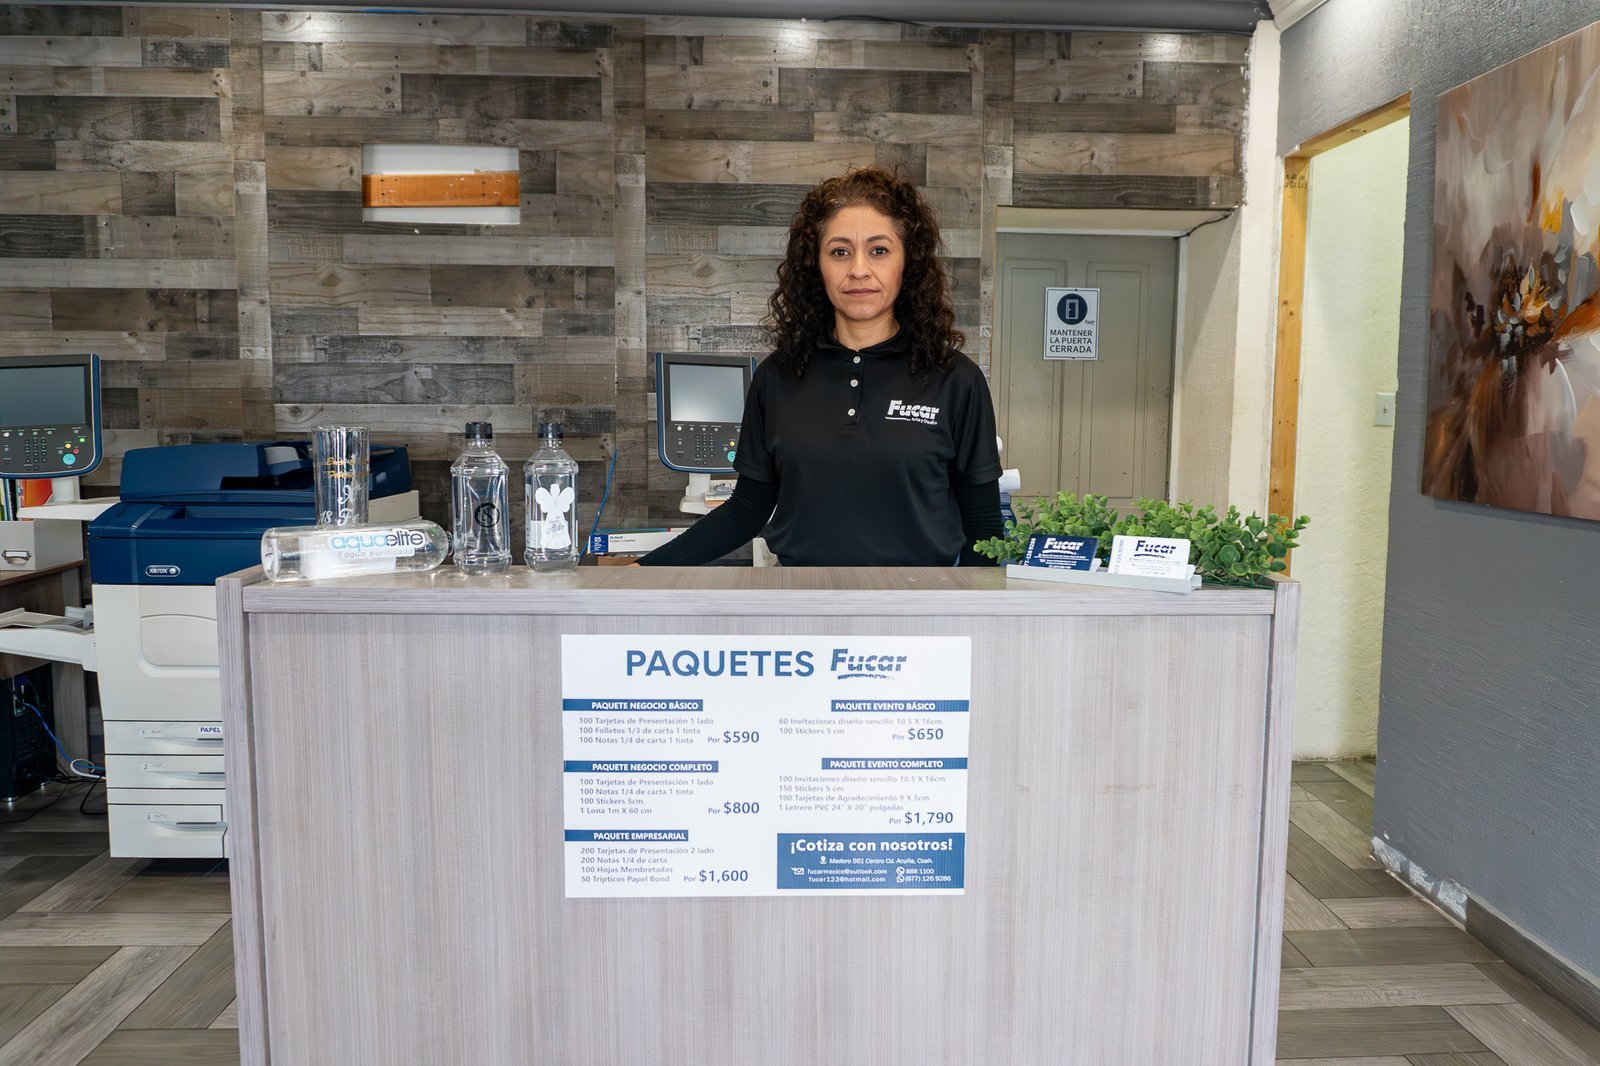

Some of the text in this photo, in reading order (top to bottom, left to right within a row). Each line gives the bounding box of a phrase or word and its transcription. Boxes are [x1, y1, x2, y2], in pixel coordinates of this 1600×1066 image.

[1050, 345, 1092, 353] CERRADA
[887, 399, 940, 419] Fucar
[331, 530, 424, 552] aquaelite
[1043, 537, 1085, 551] Fucar
[369, 549, 413, 557] purificada
[1135, 540, 1177, 555] Fucar
[149, 567, 168, 575] xerox
[627, 650, 814, 676] PAQUETES
[830, 648, 907, 672] Fucar
[592, 702, 628, 710] PAQUETE
[669, 701, 698, 709] BÁSICO
[836, 703, 871, 711] PAQUETE
[907, 702, 935, 710] BÁSICO
[595, 718, 624, 726] Tarjetas
[723, 731, 760, 744] $590
[908, 728, 944, 741] $650
[592, 764, 628, 772] PAQUETE
[830, 761, 865, 769] PAQUETE
[596, 779, 625, 787] Tarjetas
[724, 802, 760, 815] $800
[870, 804, 904, 812] pulgadas
[905, 812, 953, 825] $1,790
[594, 833, 629, 841] PAQUETE
[597, 848, 626, 856] Tarjetas
[791, 839, 953, 854] ¡Cotiza con nosotros!
[699, 870, 748, 883] $1,600
